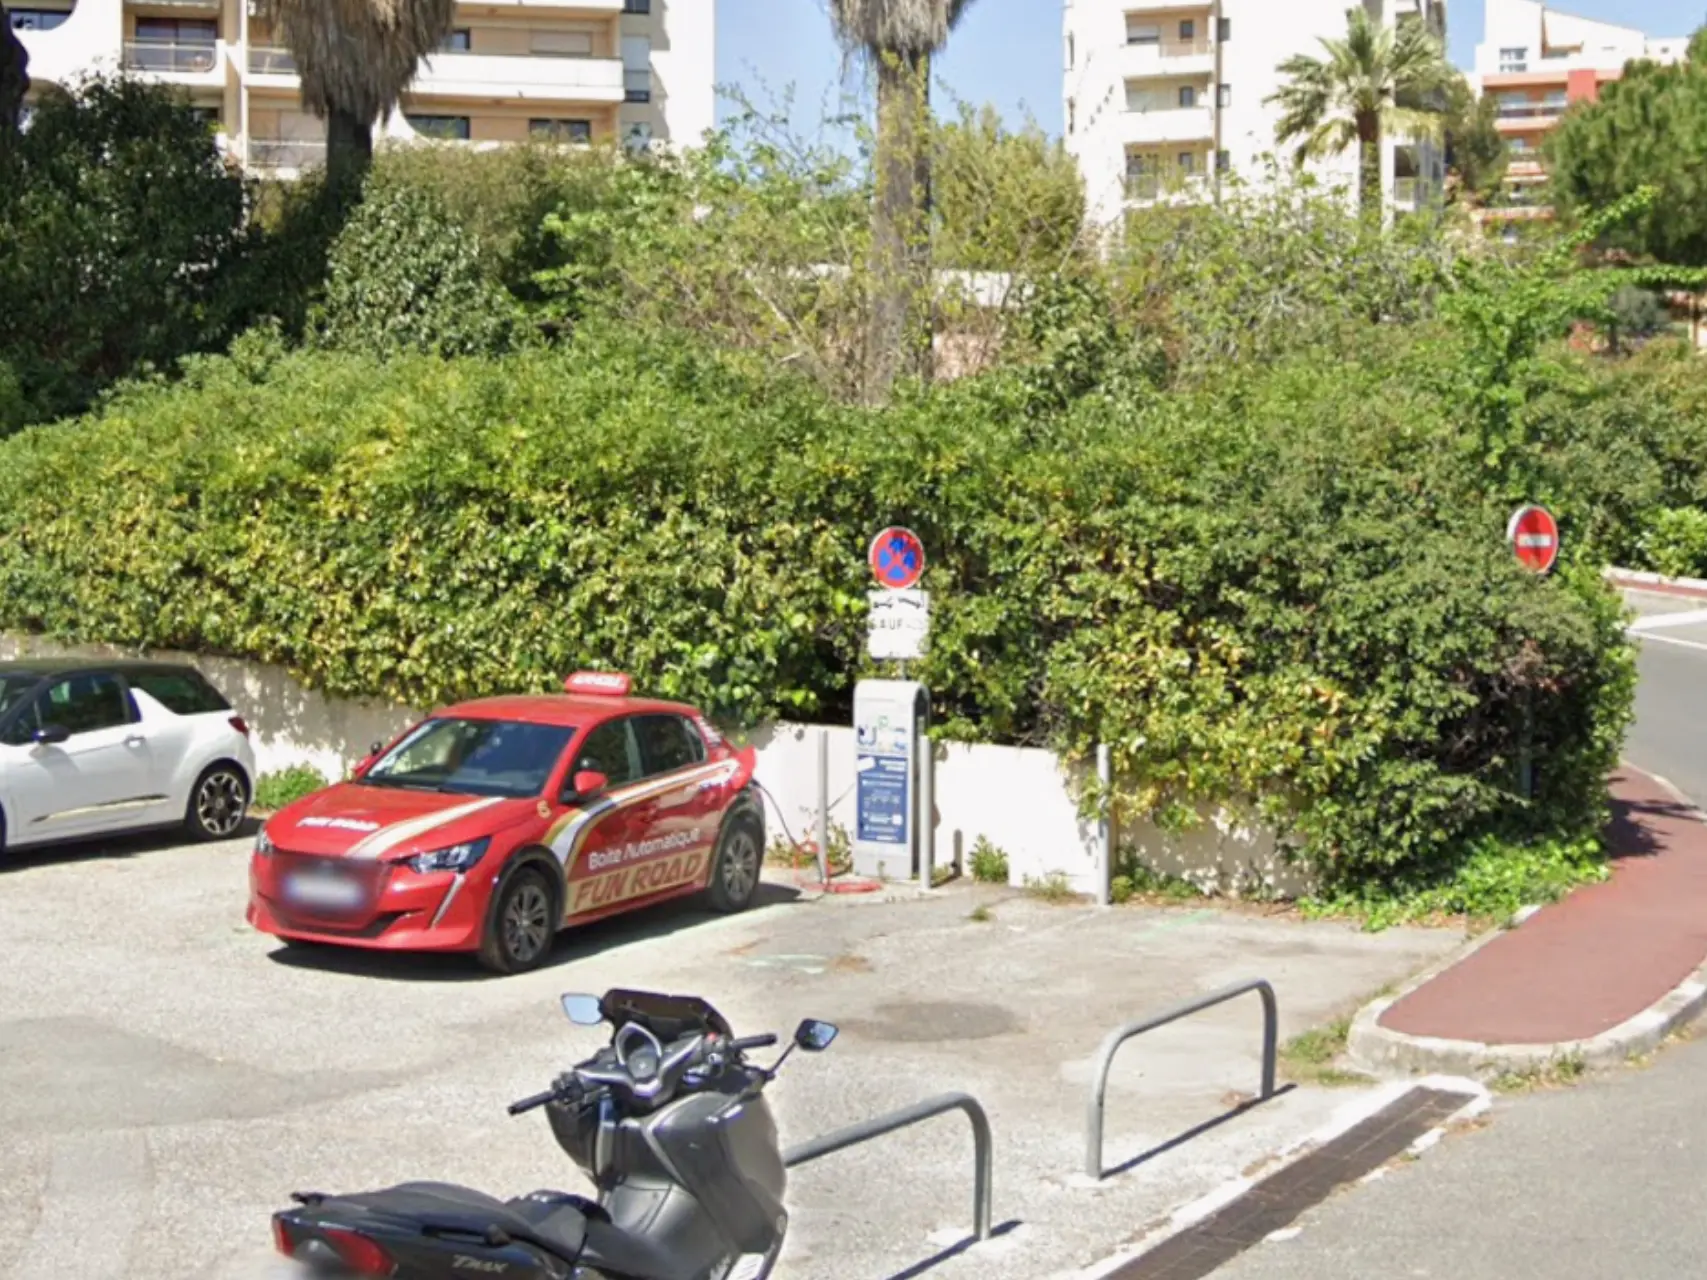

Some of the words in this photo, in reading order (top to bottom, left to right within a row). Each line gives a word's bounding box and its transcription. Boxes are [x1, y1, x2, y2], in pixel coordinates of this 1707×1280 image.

[623, 828, 700, 861] Automatique
[574, 872, 630, 909] FUN
[630, 852, 705, 892] ROAD
